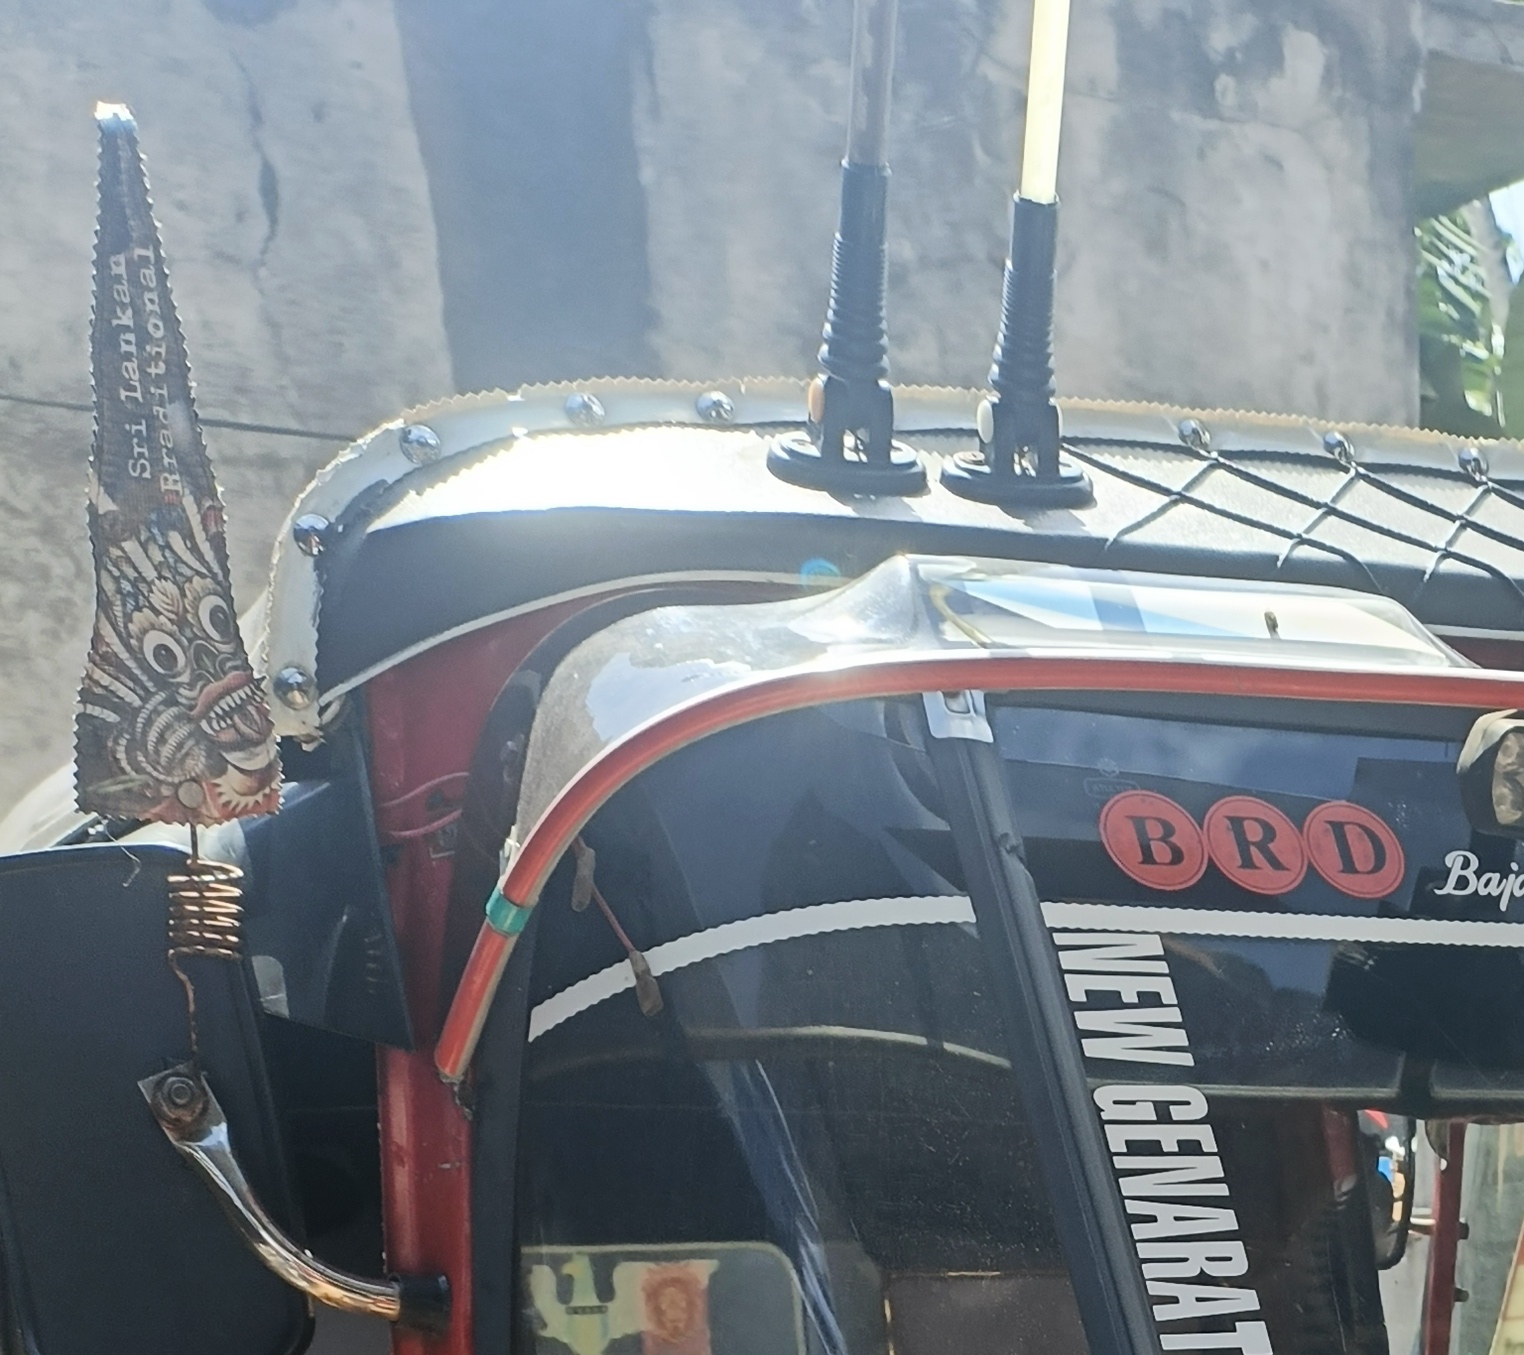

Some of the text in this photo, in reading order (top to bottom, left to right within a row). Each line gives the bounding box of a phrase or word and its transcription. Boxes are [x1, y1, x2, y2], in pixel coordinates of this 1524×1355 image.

[108, 251, 152, 479] Sri Lankan
[1052, 931, 1195, 1067] NEW
